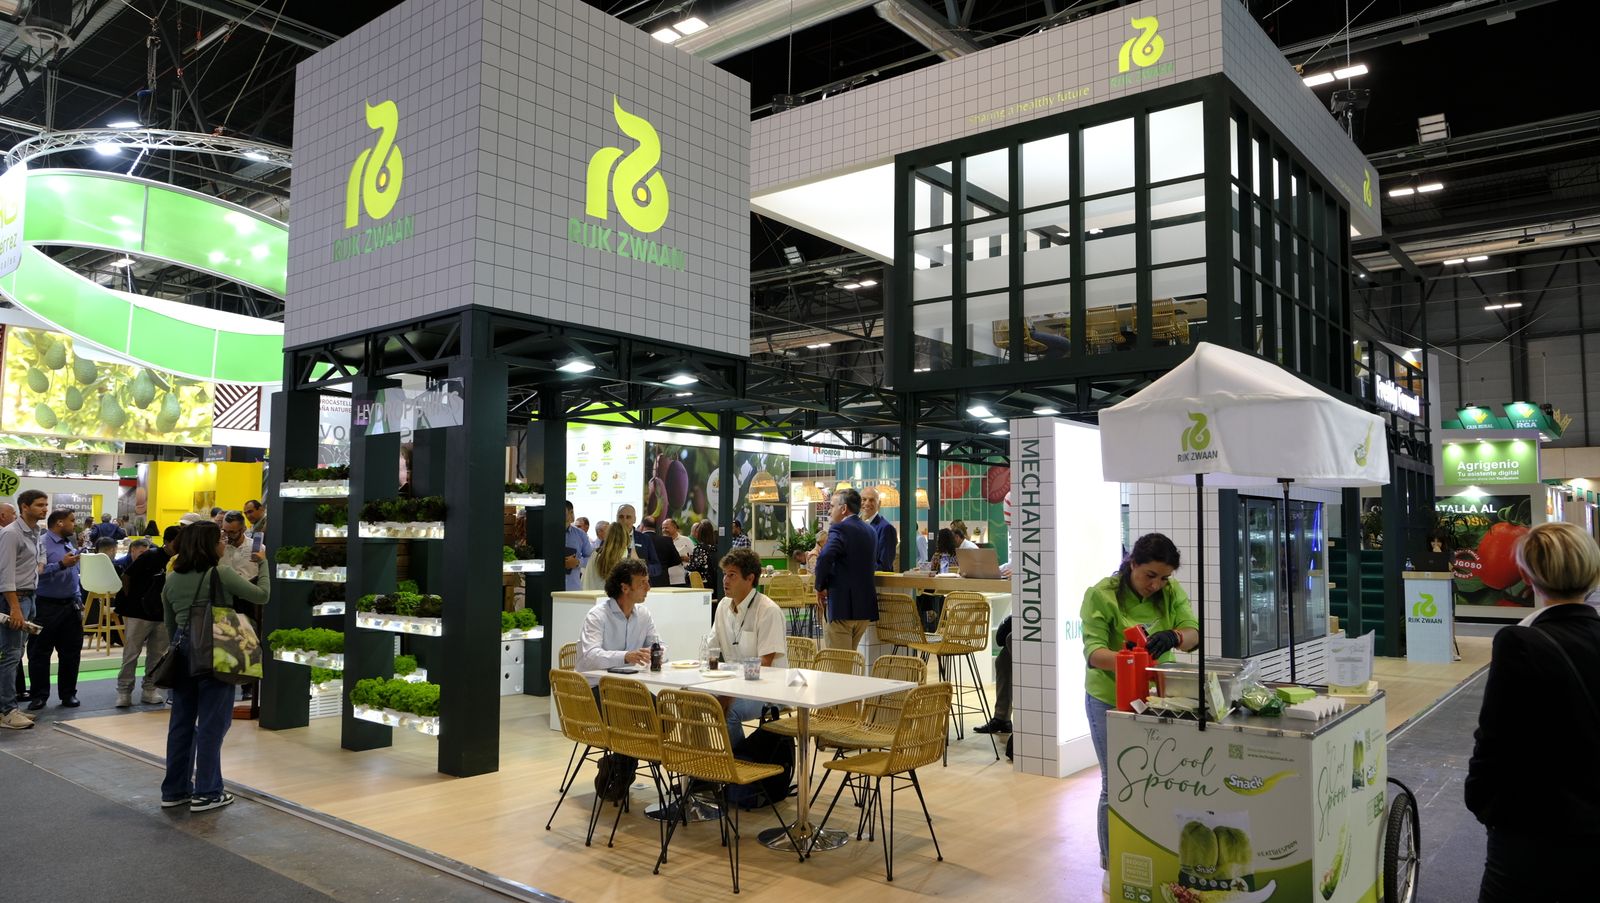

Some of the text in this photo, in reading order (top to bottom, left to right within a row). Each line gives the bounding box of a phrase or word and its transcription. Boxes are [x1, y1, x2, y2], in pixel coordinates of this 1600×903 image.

[1016, 95, 1055, 114] healthy
[1056, 86, 1090, 102] future
[332, 215, 413, 263] RIJK ZWAAN
[567, 217, 685, 272] RIJK ZWAAN
[1457, 459, 1519, 472] Agrigenio
[1498, 469, 1520, 477] digital
[1480, 504, 1498, 514] AL
[1153, 737, 1217, 777] Cool
[1117, 745, 1220, 809] Spoon
[1229, 774, 1264, 790] Snack
